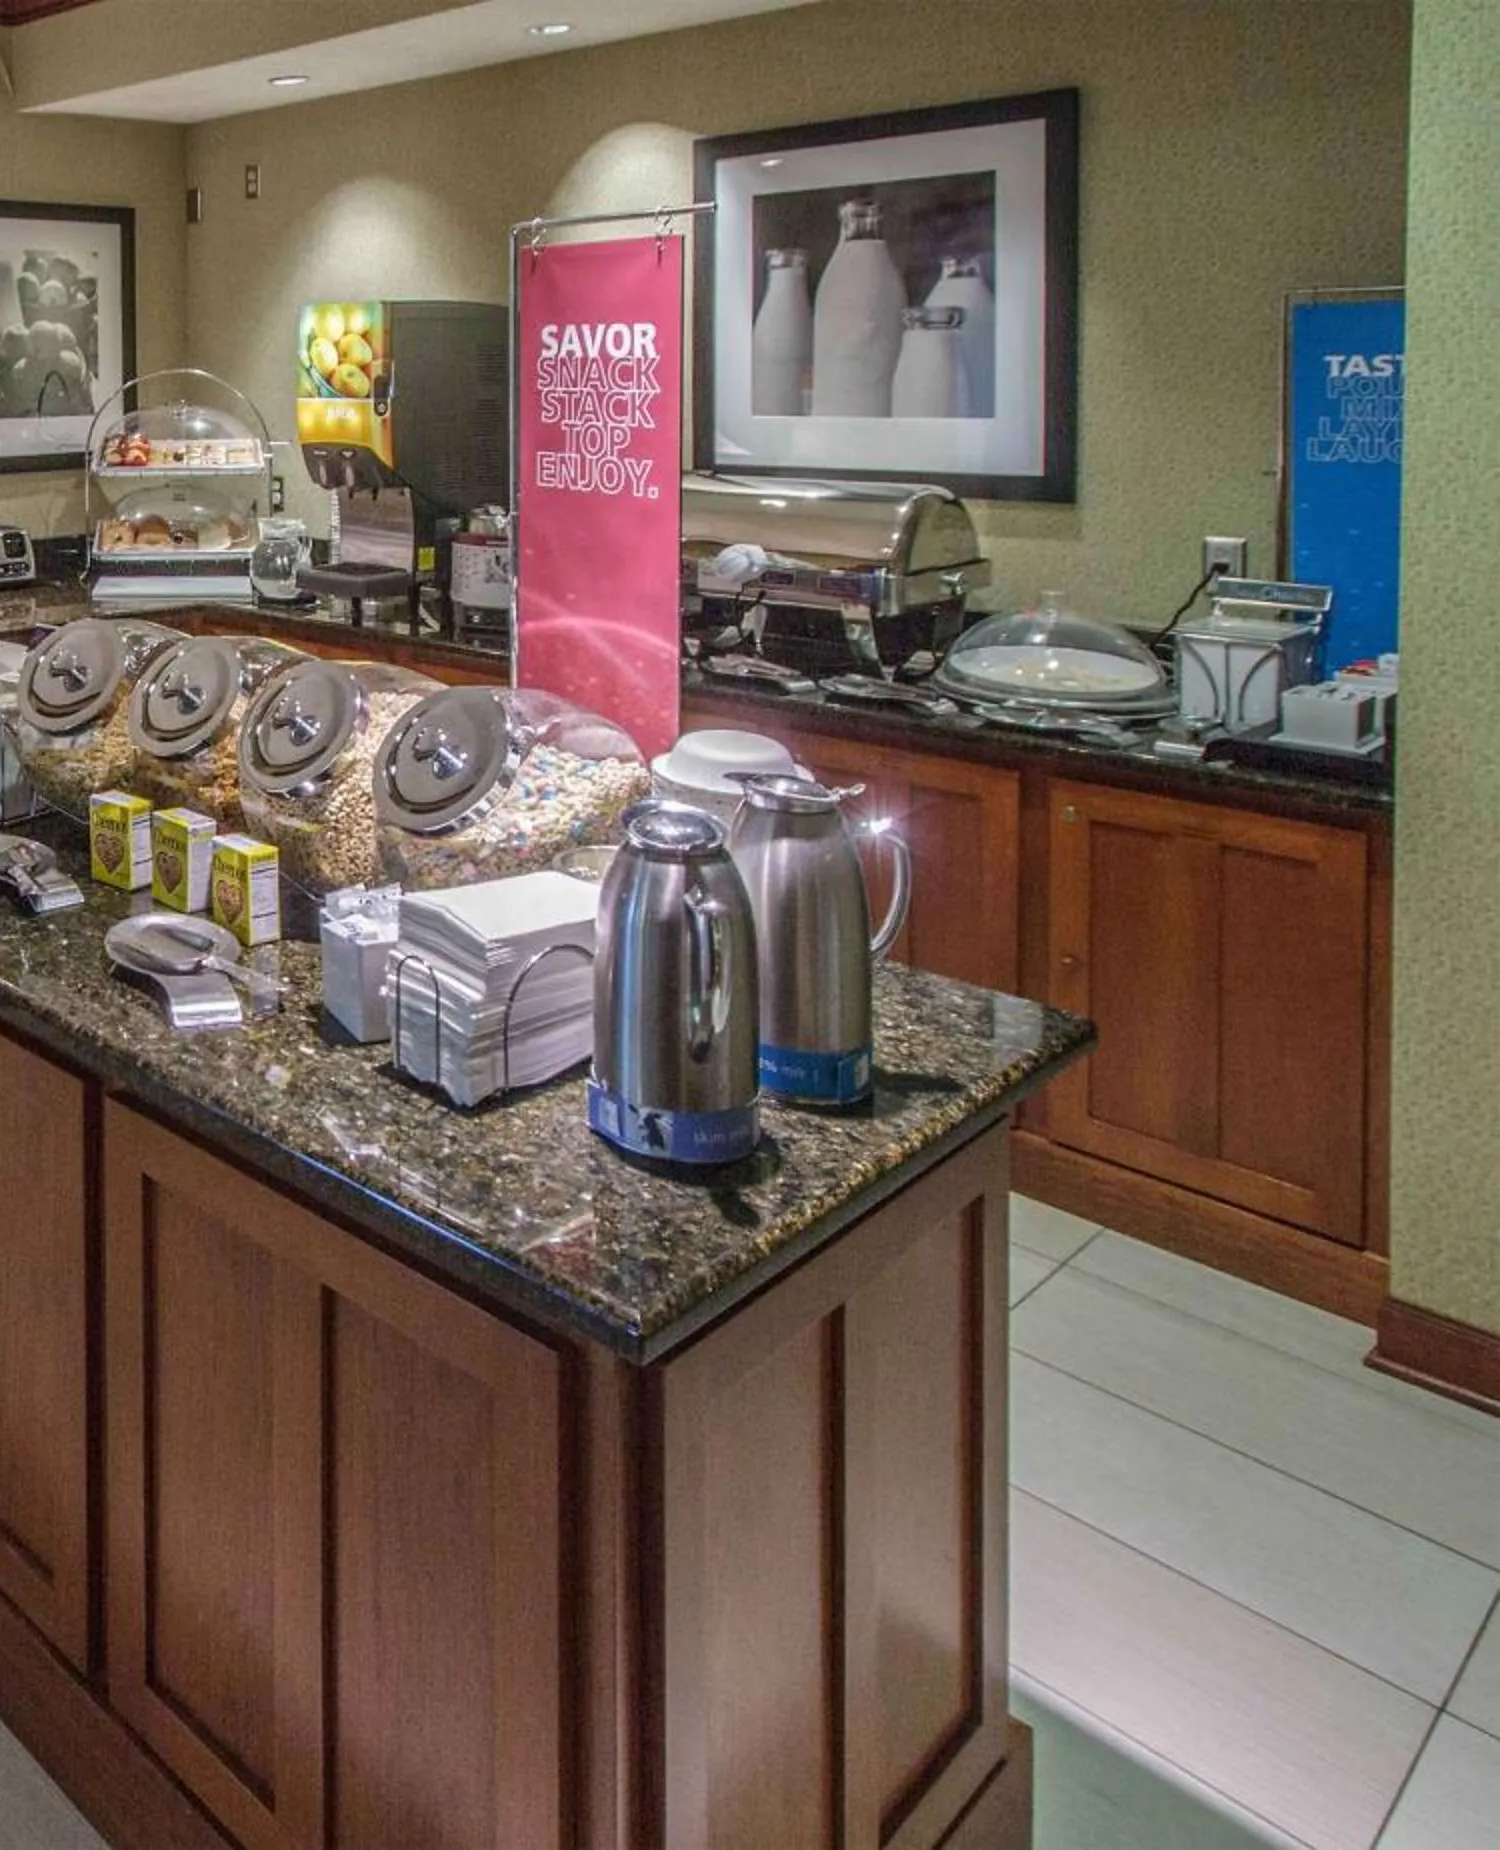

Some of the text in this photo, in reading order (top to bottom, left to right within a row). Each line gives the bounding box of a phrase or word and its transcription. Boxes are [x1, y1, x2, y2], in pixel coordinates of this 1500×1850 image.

[540, 323, 657, 357] SAVOR
[537, 355, 661, 391] SNACK
[541, 388, 656, 428] STACK
[562, 421, 631, 458] TOP
[536, 452, 659, 499] ENJOY.
